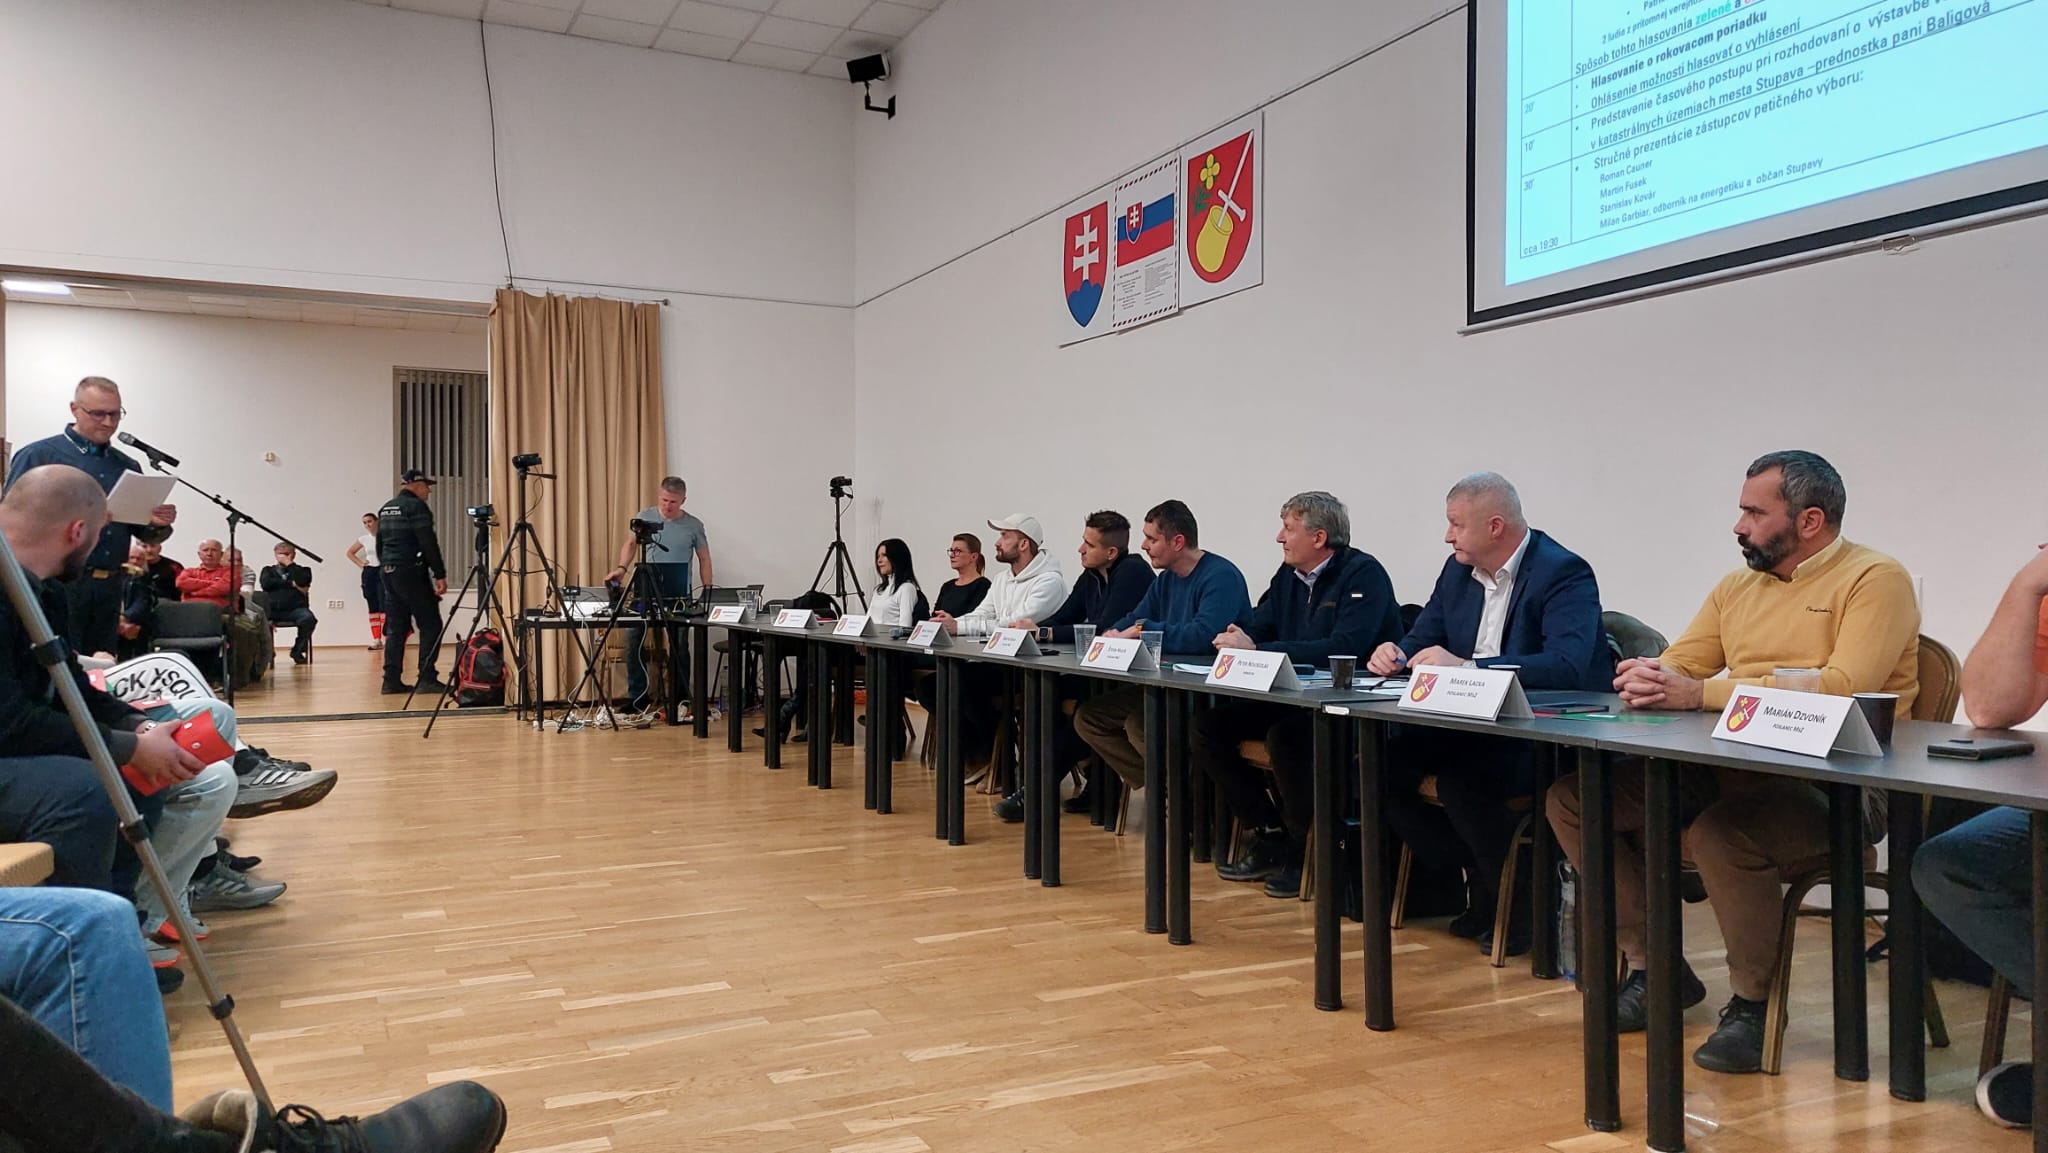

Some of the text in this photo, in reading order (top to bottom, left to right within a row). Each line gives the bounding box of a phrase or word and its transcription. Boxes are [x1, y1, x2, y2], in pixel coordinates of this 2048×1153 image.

[1575, 54, 1610, 76] Spôsob
[1611, 42, 1636, 60] tohto
[1638, 18, 1693, 49] hlasovania
[1695, 0, 1732, 26] zelené
[1591, 11, 1767, 90] Hlasovanie o rokovacom poriadku
[1591, 17, 1801, 110] Ohlásenie možnosti hlasovať o vyhlásení
[1591, 0, 1930, 130] Predstavenie časového postupu pri rozhodovaní o výstavbe
[1590, 140, 1597, 150] v
[1599, 116, 1664, 148] katastrálnych
[1666, 95, 1716, 123] územiach
[1719, 84, 1752, 105] mesta
[1755, 66, 1804, 92] Stupava
[1893, 21, 1922, 48] pani
[1926, 0, 1991, 33] Baligová
[1594, 70, 1865, 169] Stručné prezentácie zástupcov petičného výboru:
[1600, 159, 1653, 183] Roman Cauner
[1600, 176, 1647, 199] Martin Fusek
[1600, 216, 1620, 228] Milan
[1688, 194, 1698, 204] na
[1700, 179, 1745, 200] energetiku
[1746, 178, 1752, 187] a
[1756, 169, 1784, 184] občan
[1786, 157, 1824, 176] Stupavy
[1600, 198, 1633, 214] Stanislav
[1523, 243, 1538, 255] cca
[1763, 705, 1828, 724] MARIÁN DZVONÍK
